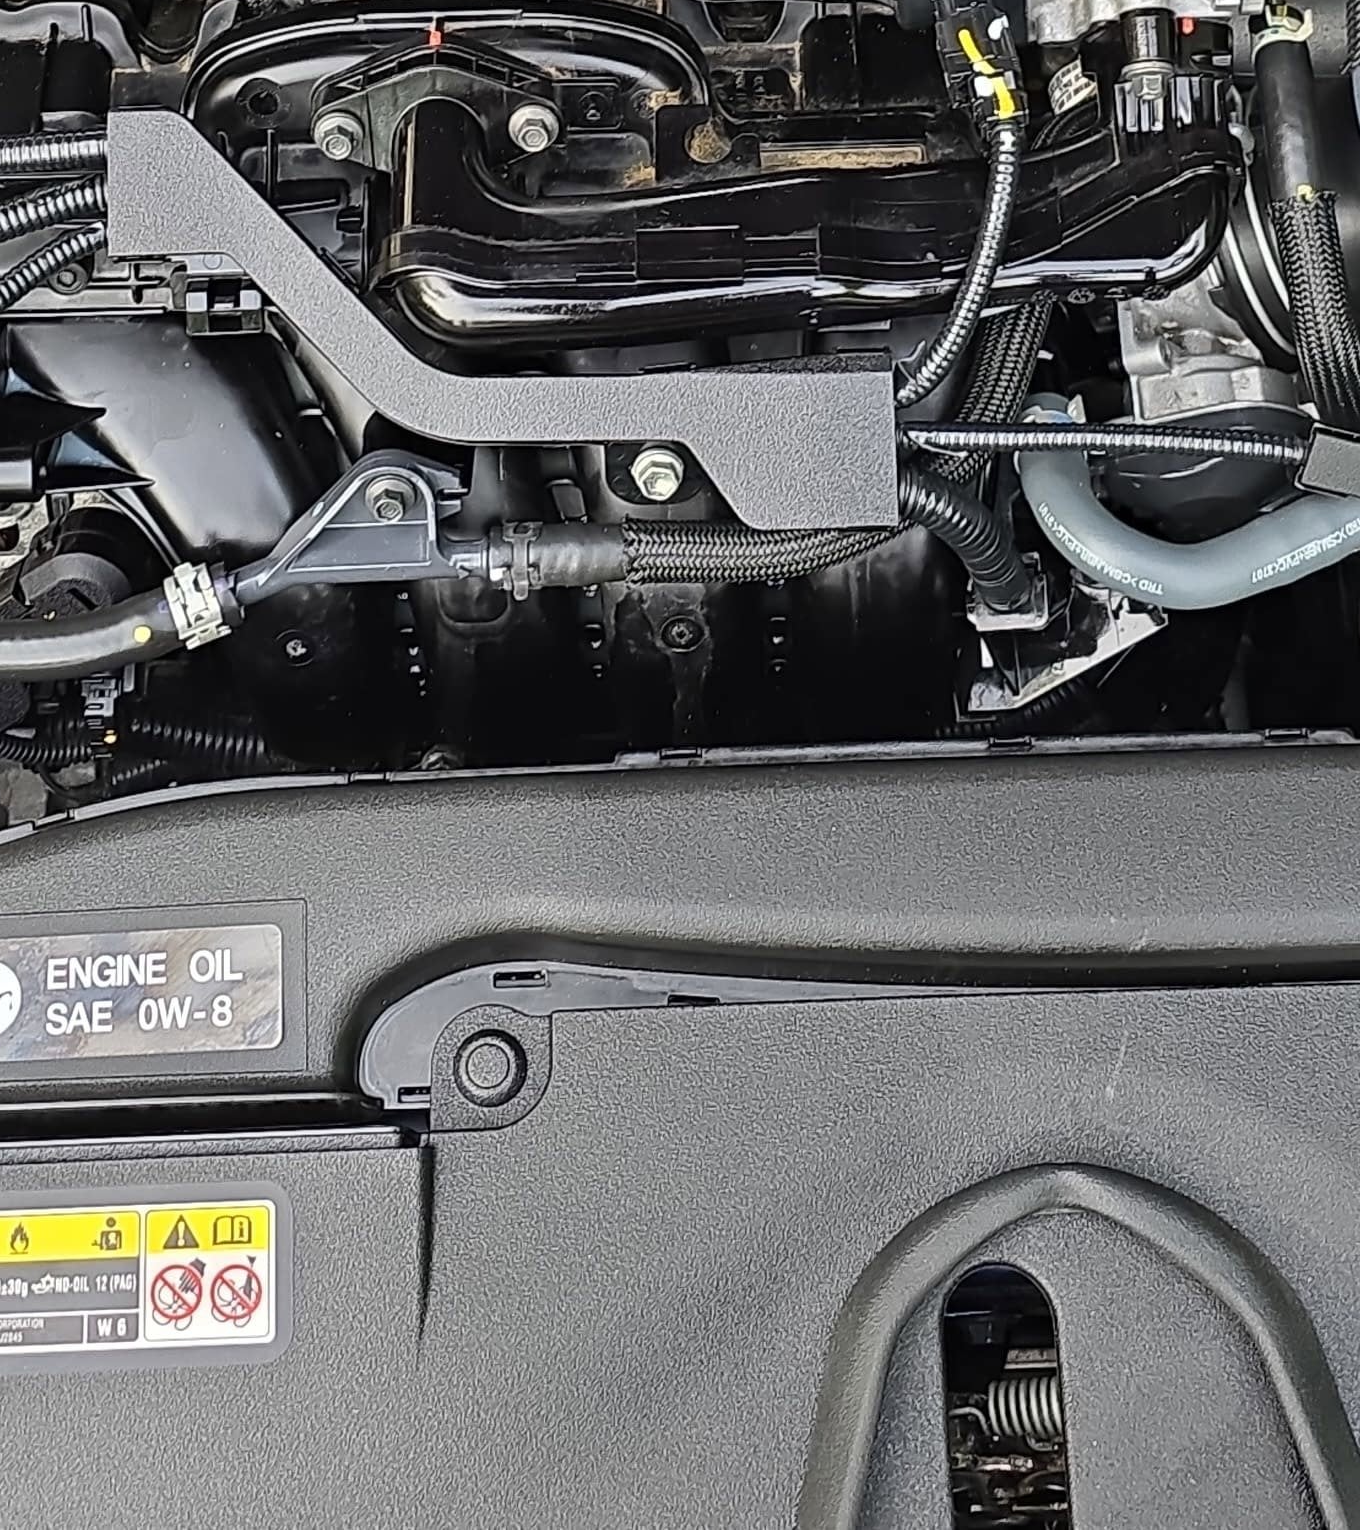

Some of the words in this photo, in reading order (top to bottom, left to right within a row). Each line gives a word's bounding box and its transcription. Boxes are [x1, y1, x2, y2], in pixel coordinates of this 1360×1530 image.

[46, 952, 167, 991] ENGINE
[189, 949, 242, 984] OIL
[45, 1000, 113, 1035] SAE
[137, 995, 234, 1031] 0W-8
[95, 1274, 107, 1292] 12
[109, 1273, 137, 1294] (PAG)
[97, 1319, 112, 1337] W
[117, 1318, 127, 1335] 6
